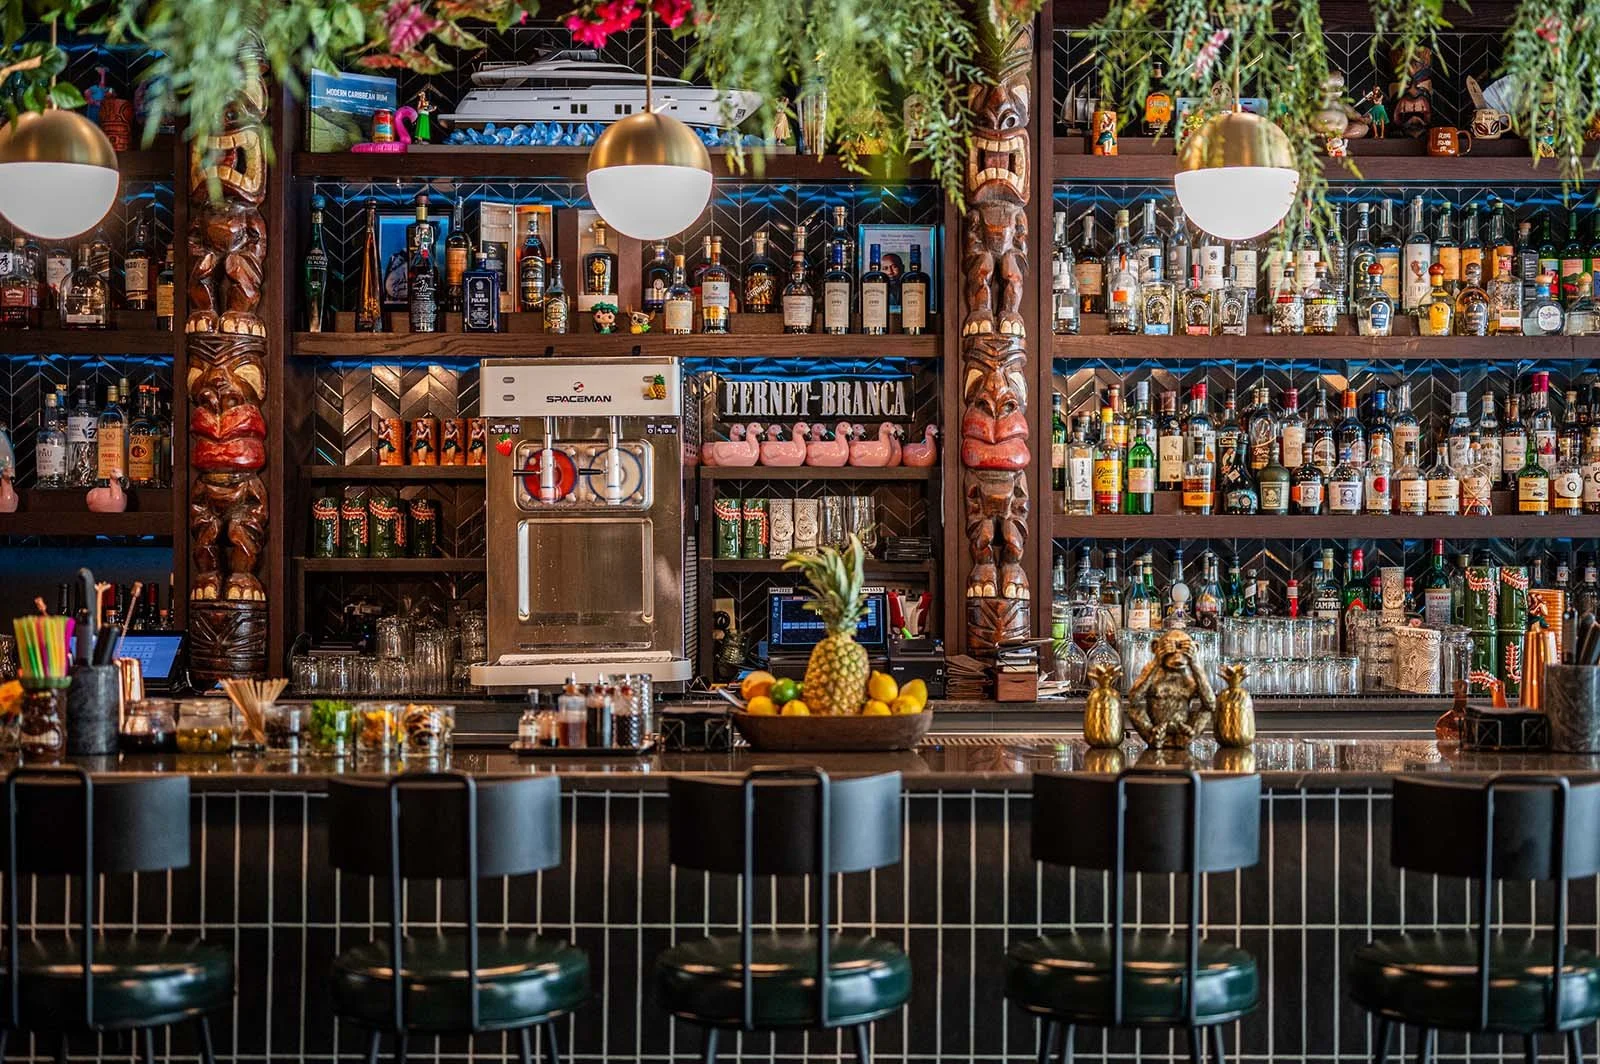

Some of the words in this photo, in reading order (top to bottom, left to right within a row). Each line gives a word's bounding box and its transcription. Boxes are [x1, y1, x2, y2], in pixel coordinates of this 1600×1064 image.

[326, 88, 347, 97] MODERN
[348, 90, 376, 100] CARIBBEAN
[376, 93, 388, 102] RUM
[546, 395, 612, 403] SPACEMAN
[722, 380, 908, 416] FERNET-BRANCA
